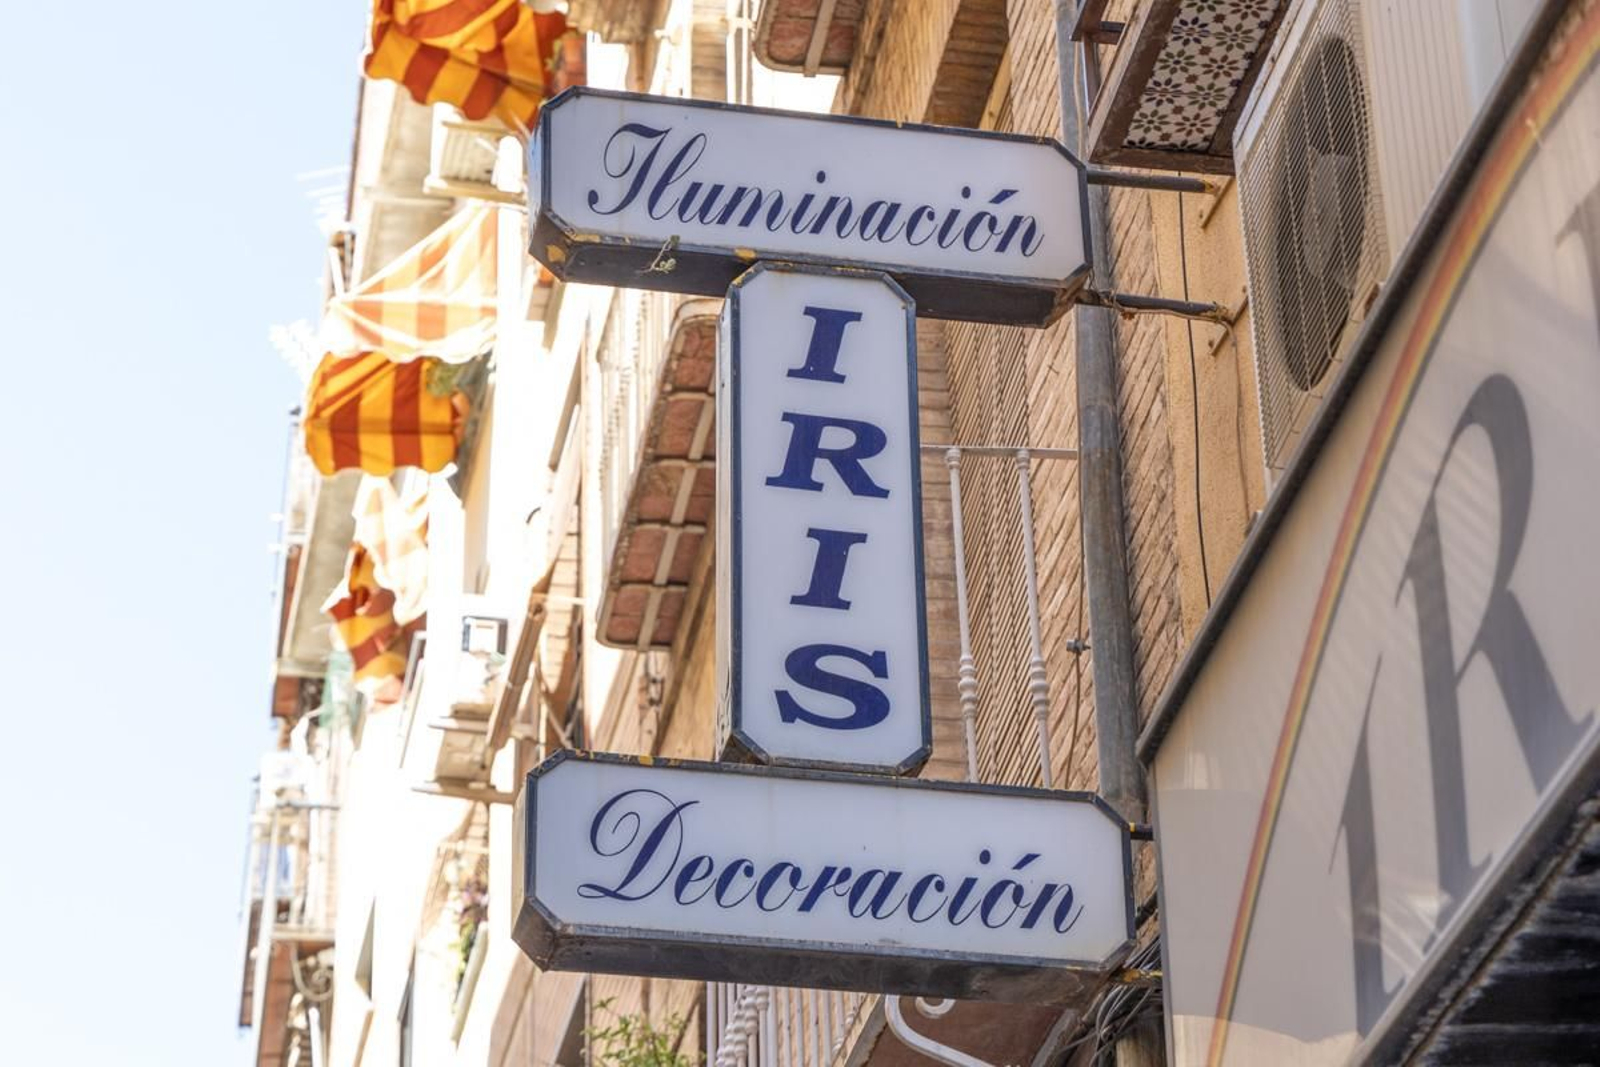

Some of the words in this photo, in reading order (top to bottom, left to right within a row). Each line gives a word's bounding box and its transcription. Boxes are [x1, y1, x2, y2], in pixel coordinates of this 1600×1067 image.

[587, 122, 1045, 259] Iluminación
[765, 306, 891, 731] IRIS
[1329, 183, 1600, 1038] IR
[576, 788, 1085, 935] Decoración
